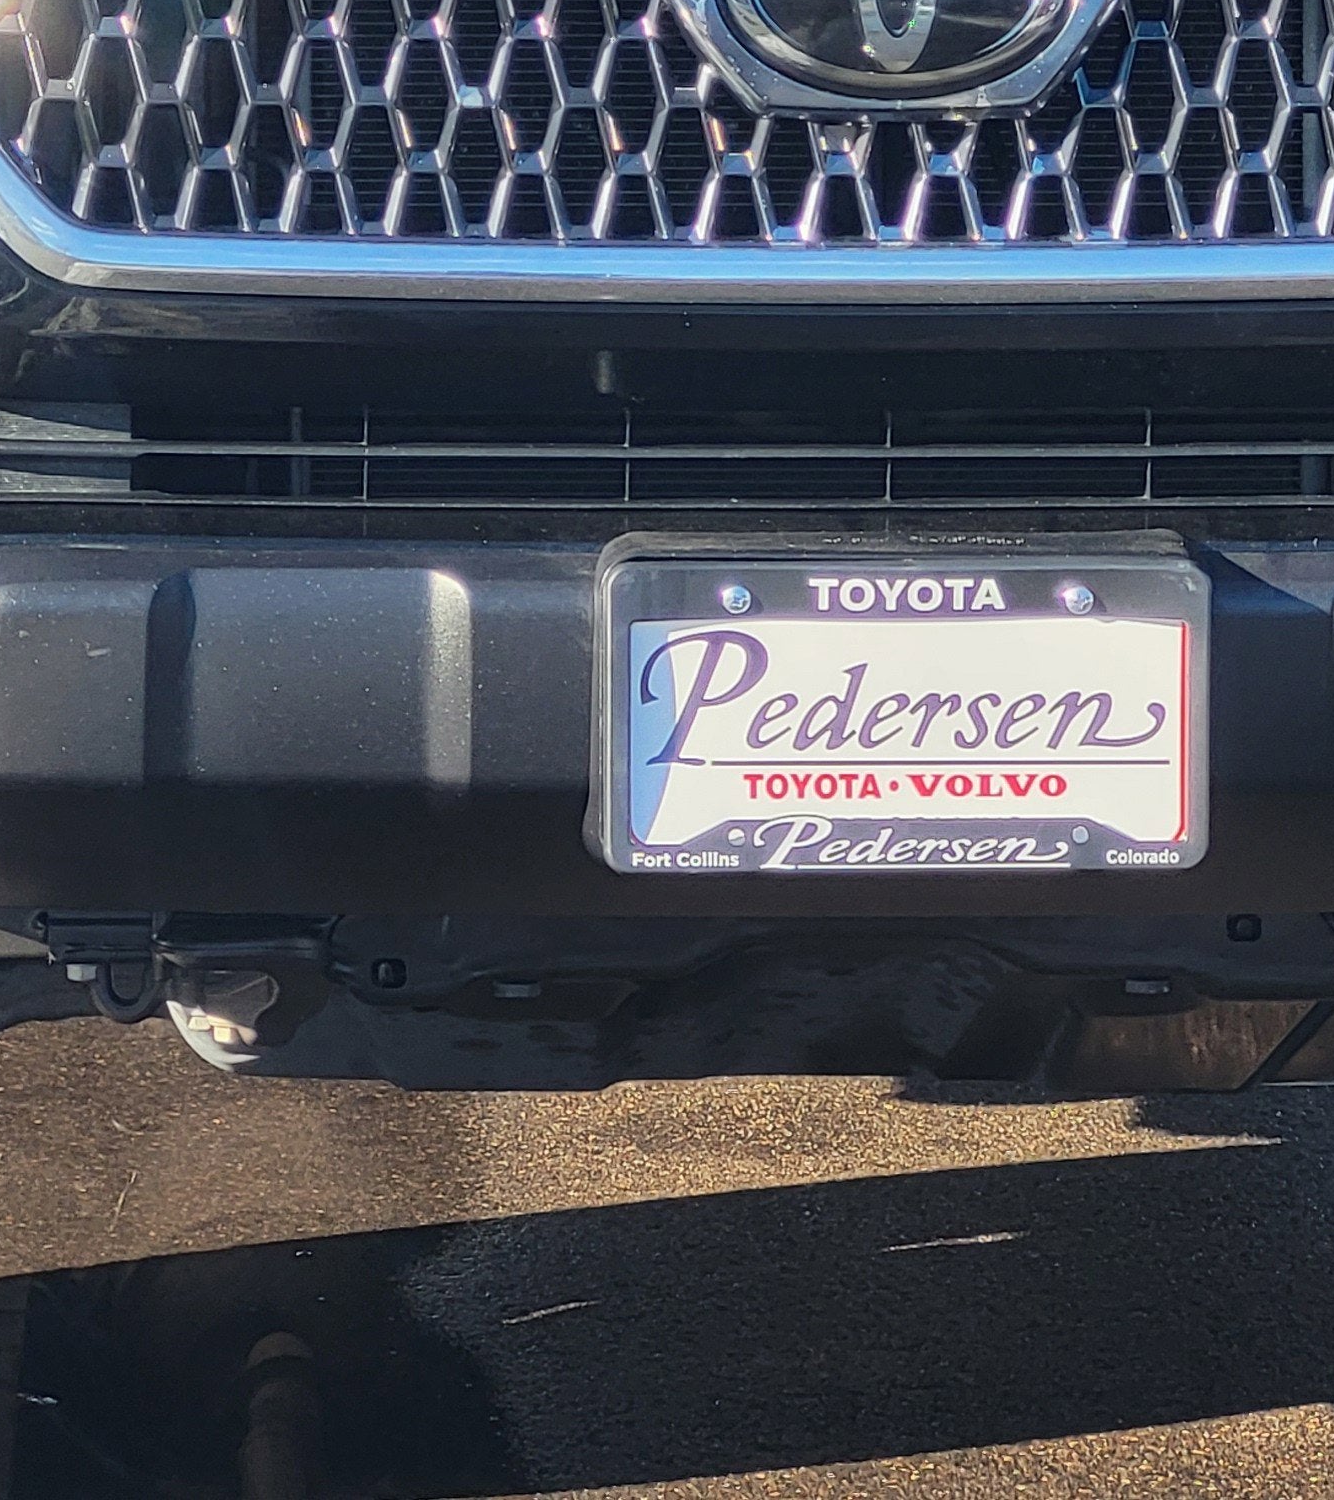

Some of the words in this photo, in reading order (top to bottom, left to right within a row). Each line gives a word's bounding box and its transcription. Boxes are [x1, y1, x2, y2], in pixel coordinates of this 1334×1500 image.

[809, 578, 1006, 612] TOYOTA
[640, 630, 1166, 766] Pedersen
[743, 773, 882, 800] TOYOTA
[906, 773, 1068, 798] VOLVO
[753, 814, 1069, 869] Pedersen
[631, 852, 672, 868] Fort
[676, 852, 740, 868] Collins
[1105, 849, 1181, 865] Colorado
